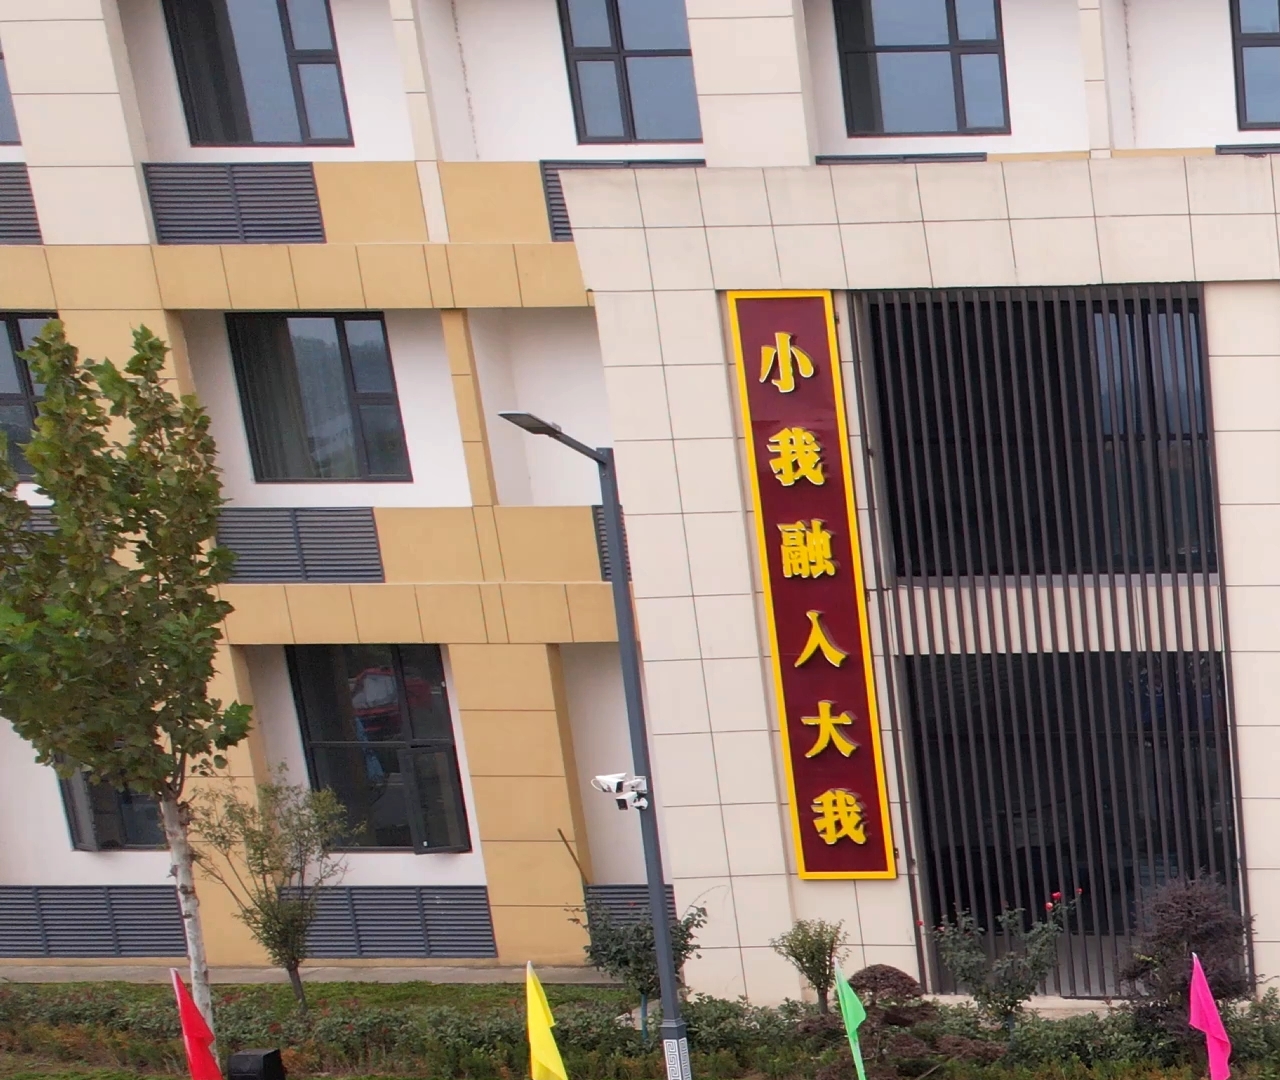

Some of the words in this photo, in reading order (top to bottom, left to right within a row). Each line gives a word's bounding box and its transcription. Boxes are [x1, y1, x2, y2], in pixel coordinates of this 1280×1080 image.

[758, 331, 868, 846] 小我融入大我
